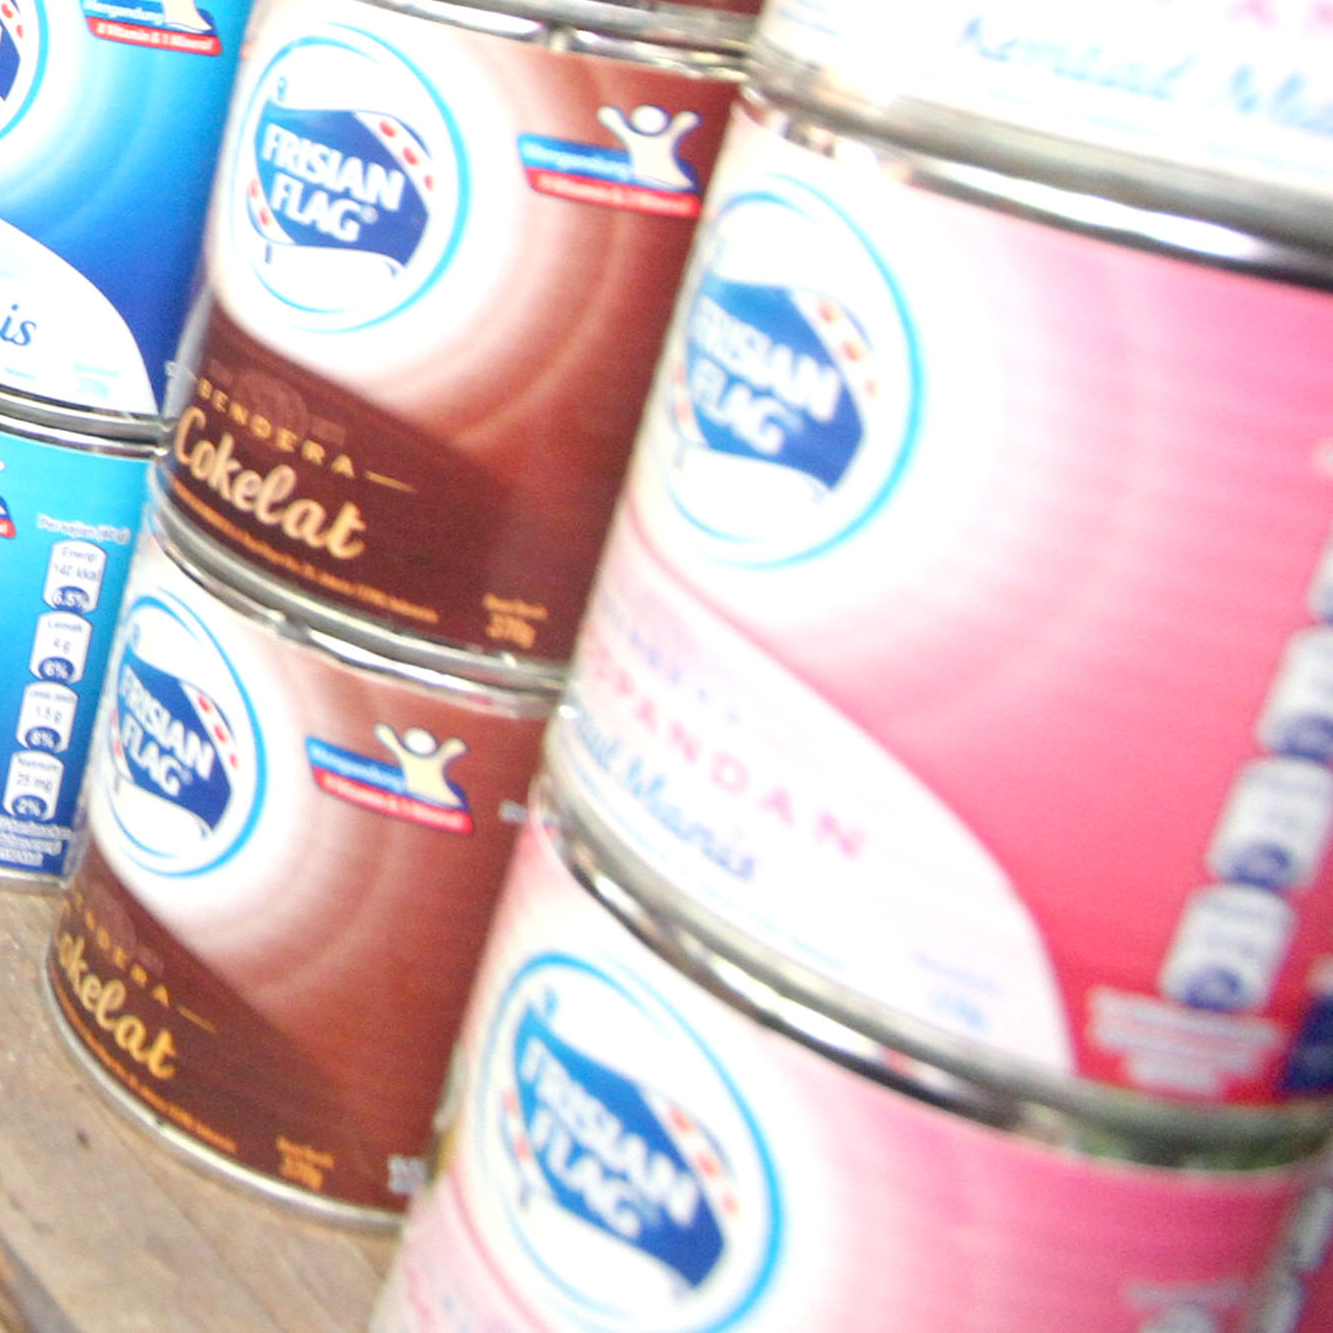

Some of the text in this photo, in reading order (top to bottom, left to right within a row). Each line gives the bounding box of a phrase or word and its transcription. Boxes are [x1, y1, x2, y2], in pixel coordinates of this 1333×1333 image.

[261, 121, 406, 213] FRISIAN
[175, 405, 367, 560] Cokelat
[198, 378, 355, 478] BENDERA
[121, 663, 215, 781] FRISIAN
[58, 932, 176, 1080] okelat
[520, 1034, 699, 1228] FRISIAN
